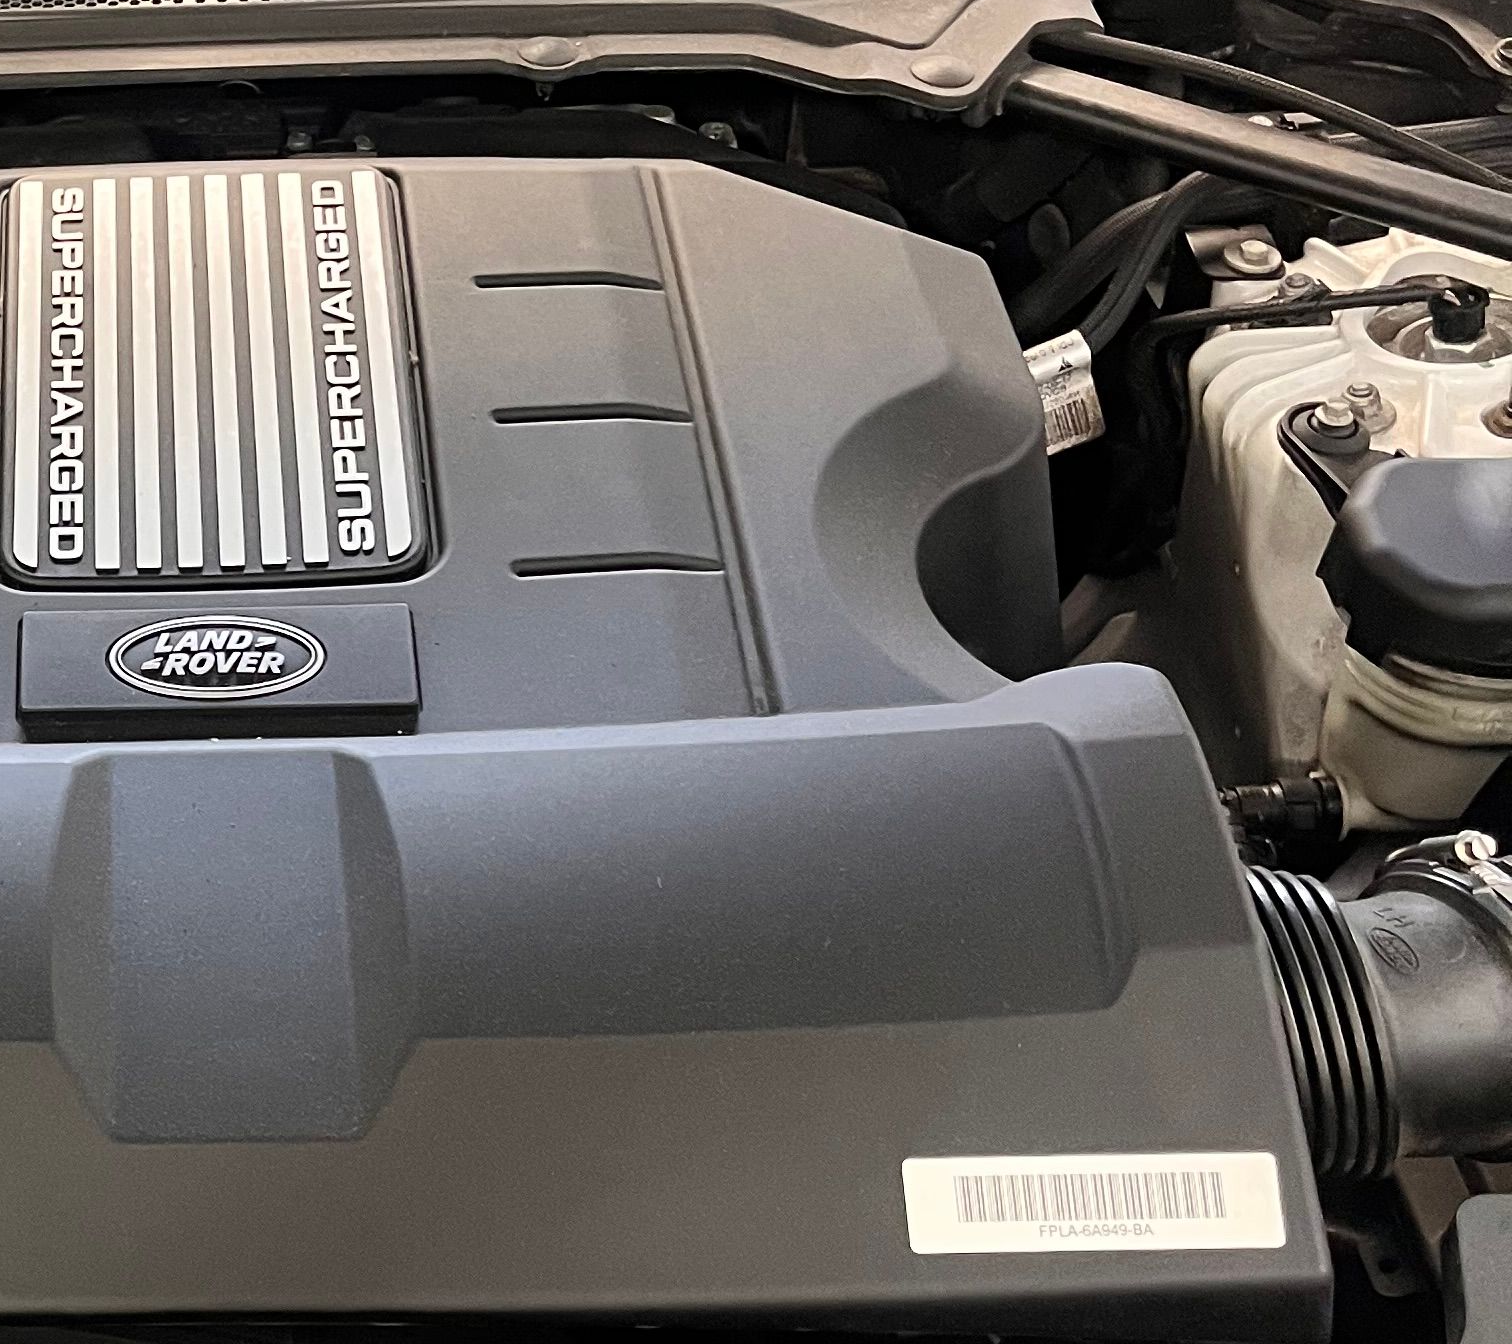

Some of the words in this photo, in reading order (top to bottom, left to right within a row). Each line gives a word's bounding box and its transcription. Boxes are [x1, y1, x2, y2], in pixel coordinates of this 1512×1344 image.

[49, 187, 85, 561] SUPERCHARGED
[312, 180, 376, 554] SUPERCHARGED
[154, 630, 254, 654] LAND
[161, 651, 286, 677] ROVER
[1039, 1223, 1155, 1237] FPLA-6A949-BA
